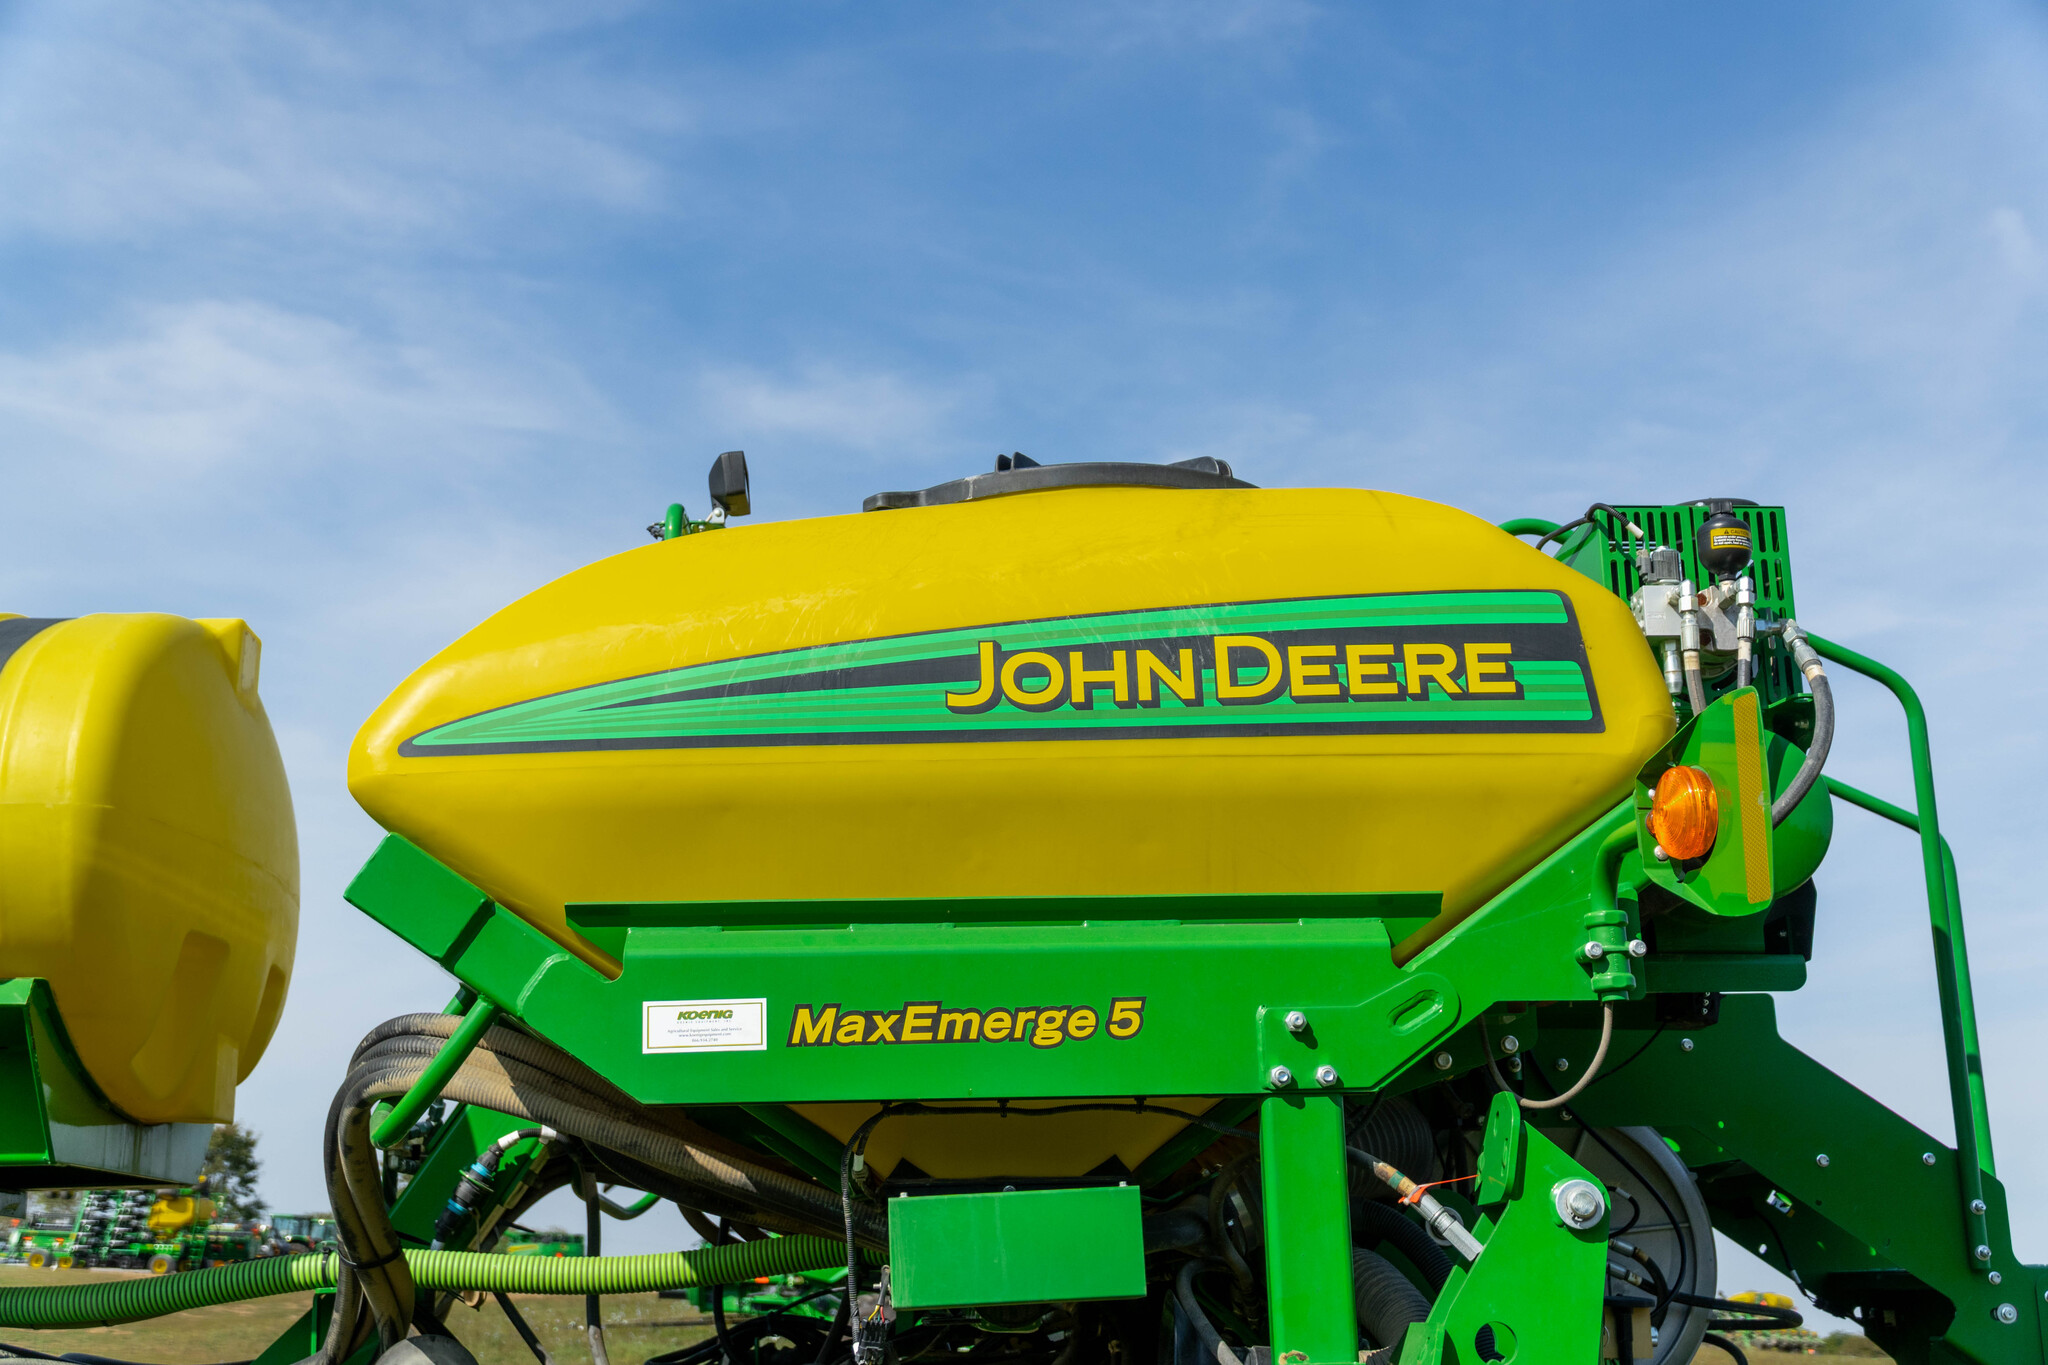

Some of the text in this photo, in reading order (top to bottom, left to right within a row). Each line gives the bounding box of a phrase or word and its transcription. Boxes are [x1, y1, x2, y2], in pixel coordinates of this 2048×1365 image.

[945, 634, 1522, 713] JOHN DEERE
[788, 998, 1145, 1048] MaxEmerge 5
